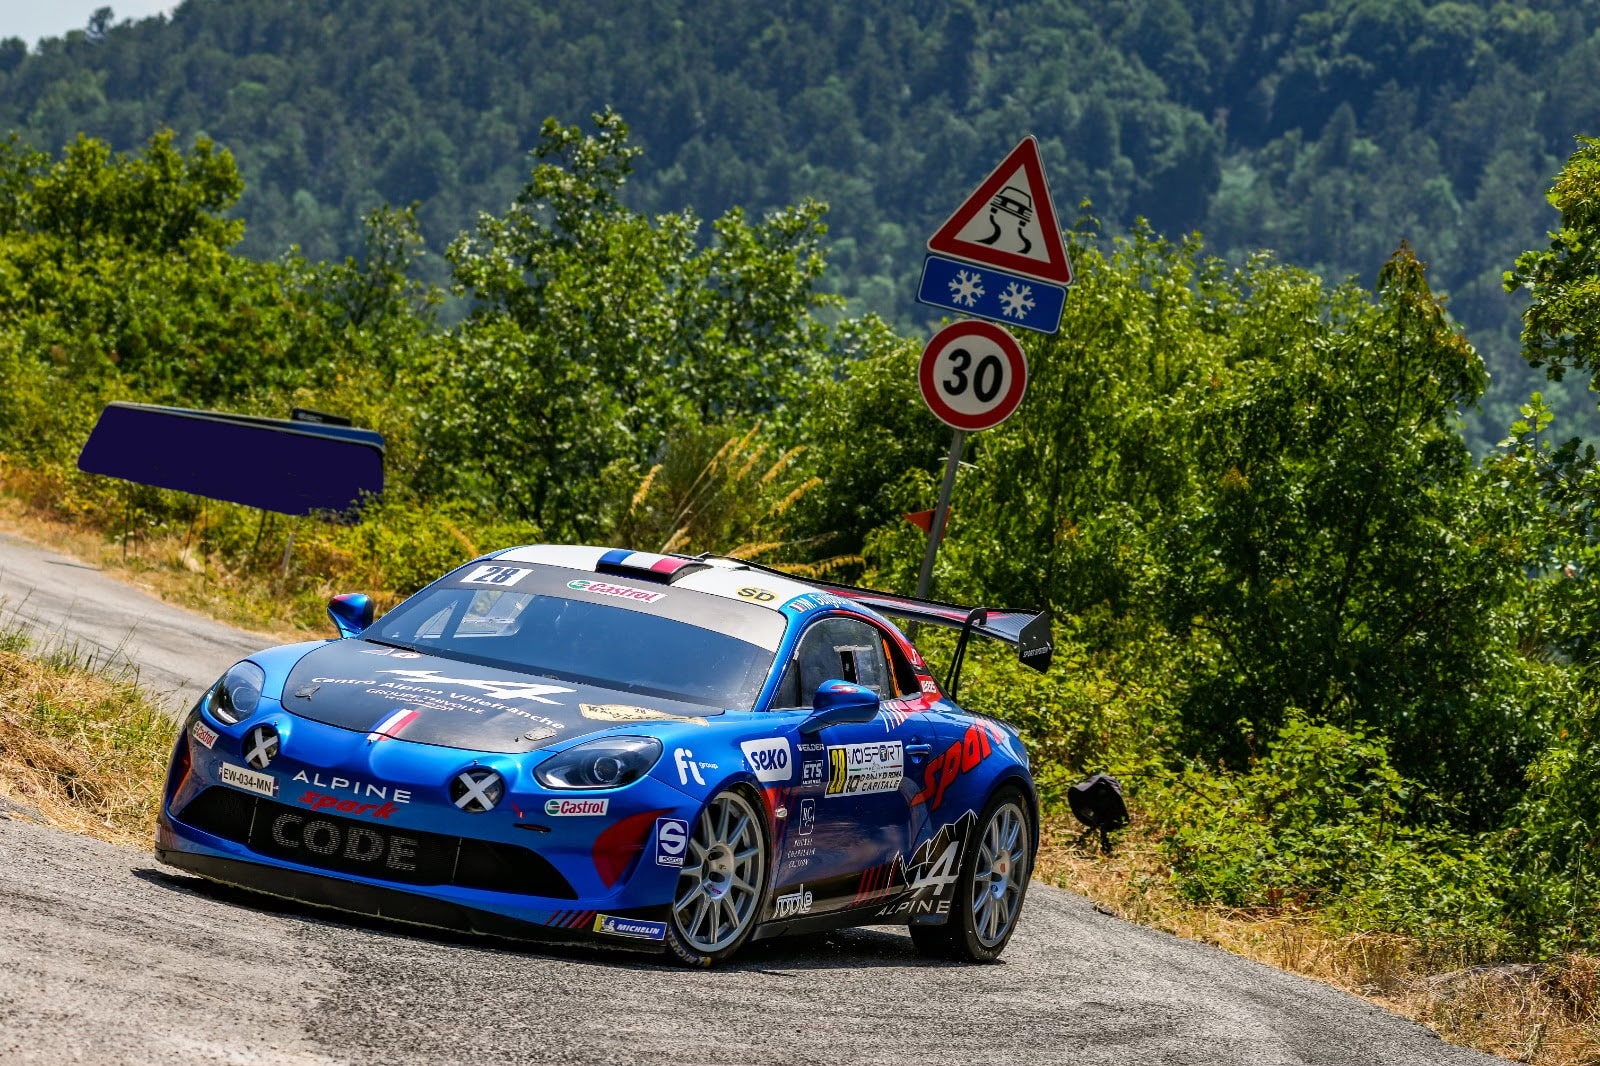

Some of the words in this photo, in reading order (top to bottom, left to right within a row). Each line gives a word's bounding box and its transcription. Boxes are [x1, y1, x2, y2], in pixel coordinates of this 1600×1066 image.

[943, 348, 1003, 403] 30
[473, 566, 520, 583] 28
[588, 583, 657, 601] Castrol
[737, 587, 775, 602] SD
[196, 725, 216, 747] Castrol
[223, 767, 272, 793] EW-034-MN
[803, 762, 823, 779] ETS
[828, 749, 846, 794] 28
[292, 769, 412, 804] ALPINE
[861, 779, 900, 792] CAPITALE
[298, 791, 401, 819] spark
[560, 800, 605, 815] Castrol
[272, 813, 418, 872] CODE
[875, 899, 951, 918] ALPINE
[616, 923, 661, 935] MICHELIN
